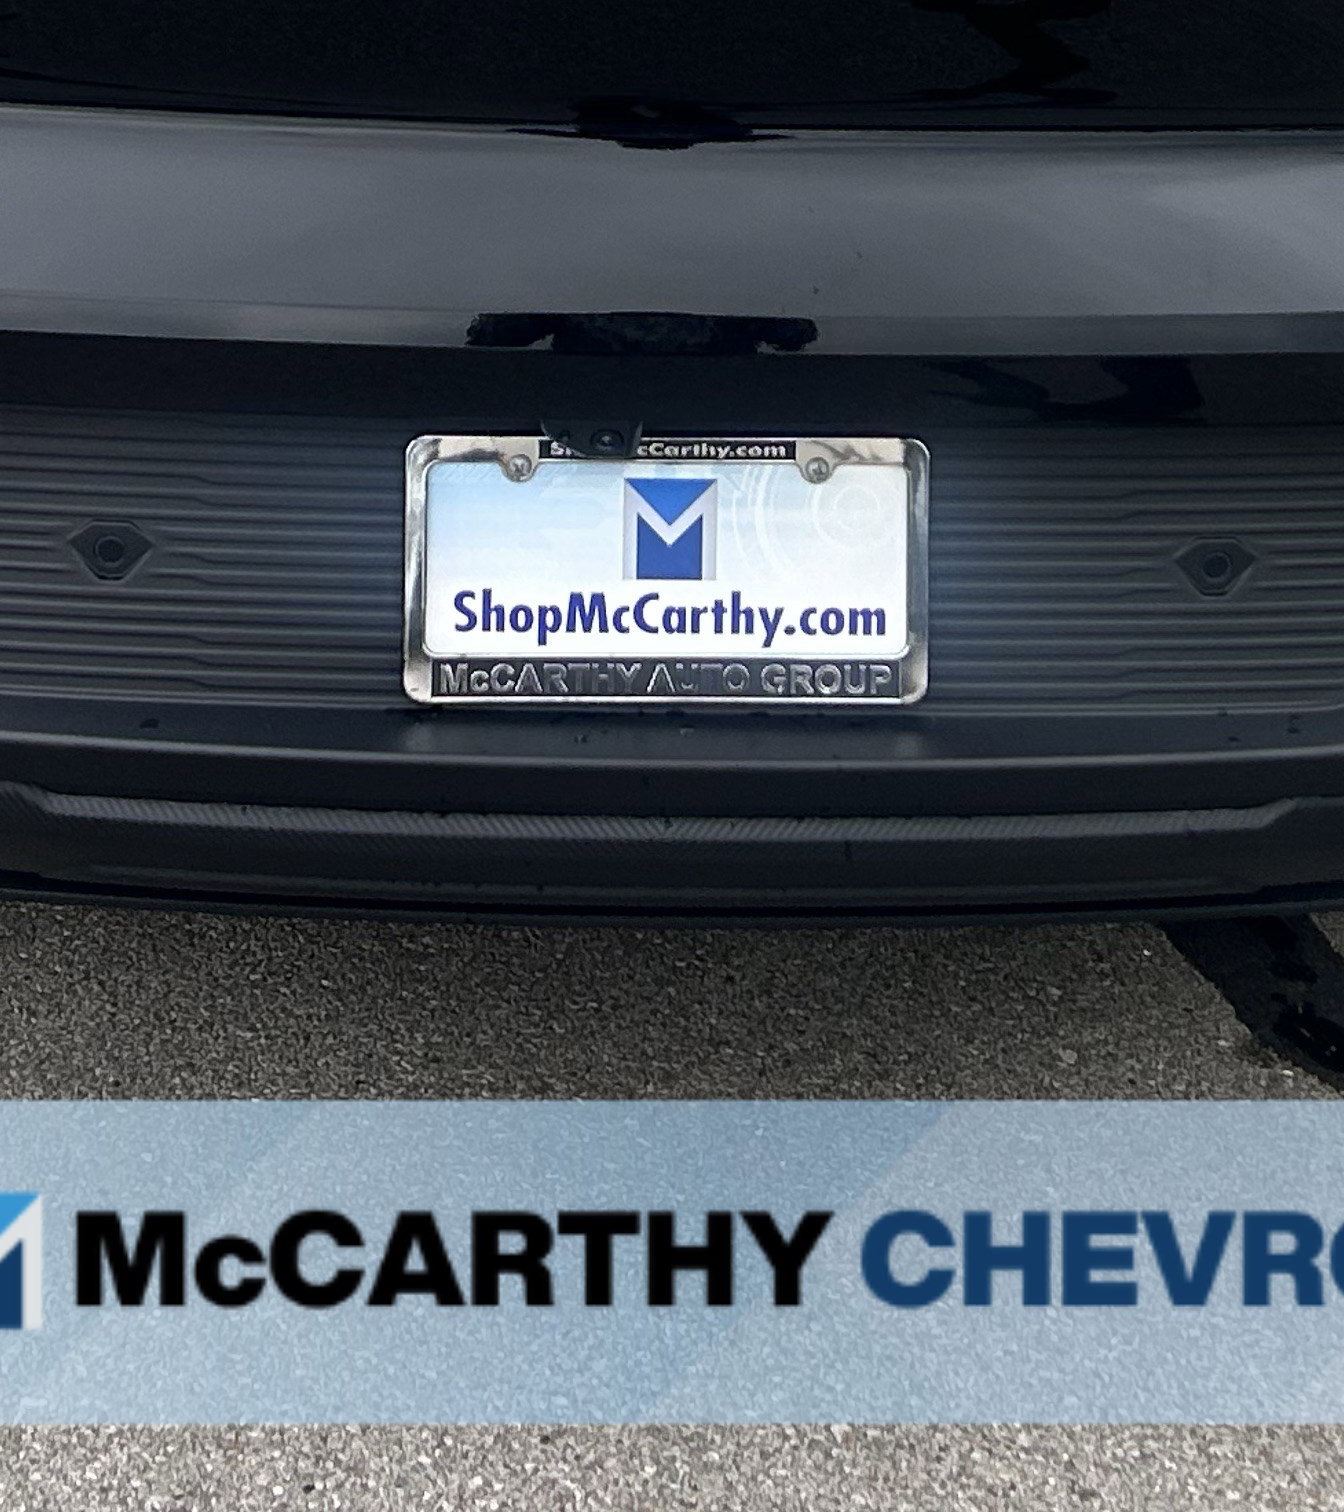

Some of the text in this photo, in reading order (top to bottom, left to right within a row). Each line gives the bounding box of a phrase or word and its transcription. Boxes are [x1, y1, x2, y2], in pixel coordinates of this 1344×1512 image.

[454, 588, 886, 647] ShopMcCarthy.com
[439, 662, 642, 693] McCARTHY
[760, 663, 892, 694] GROUP
